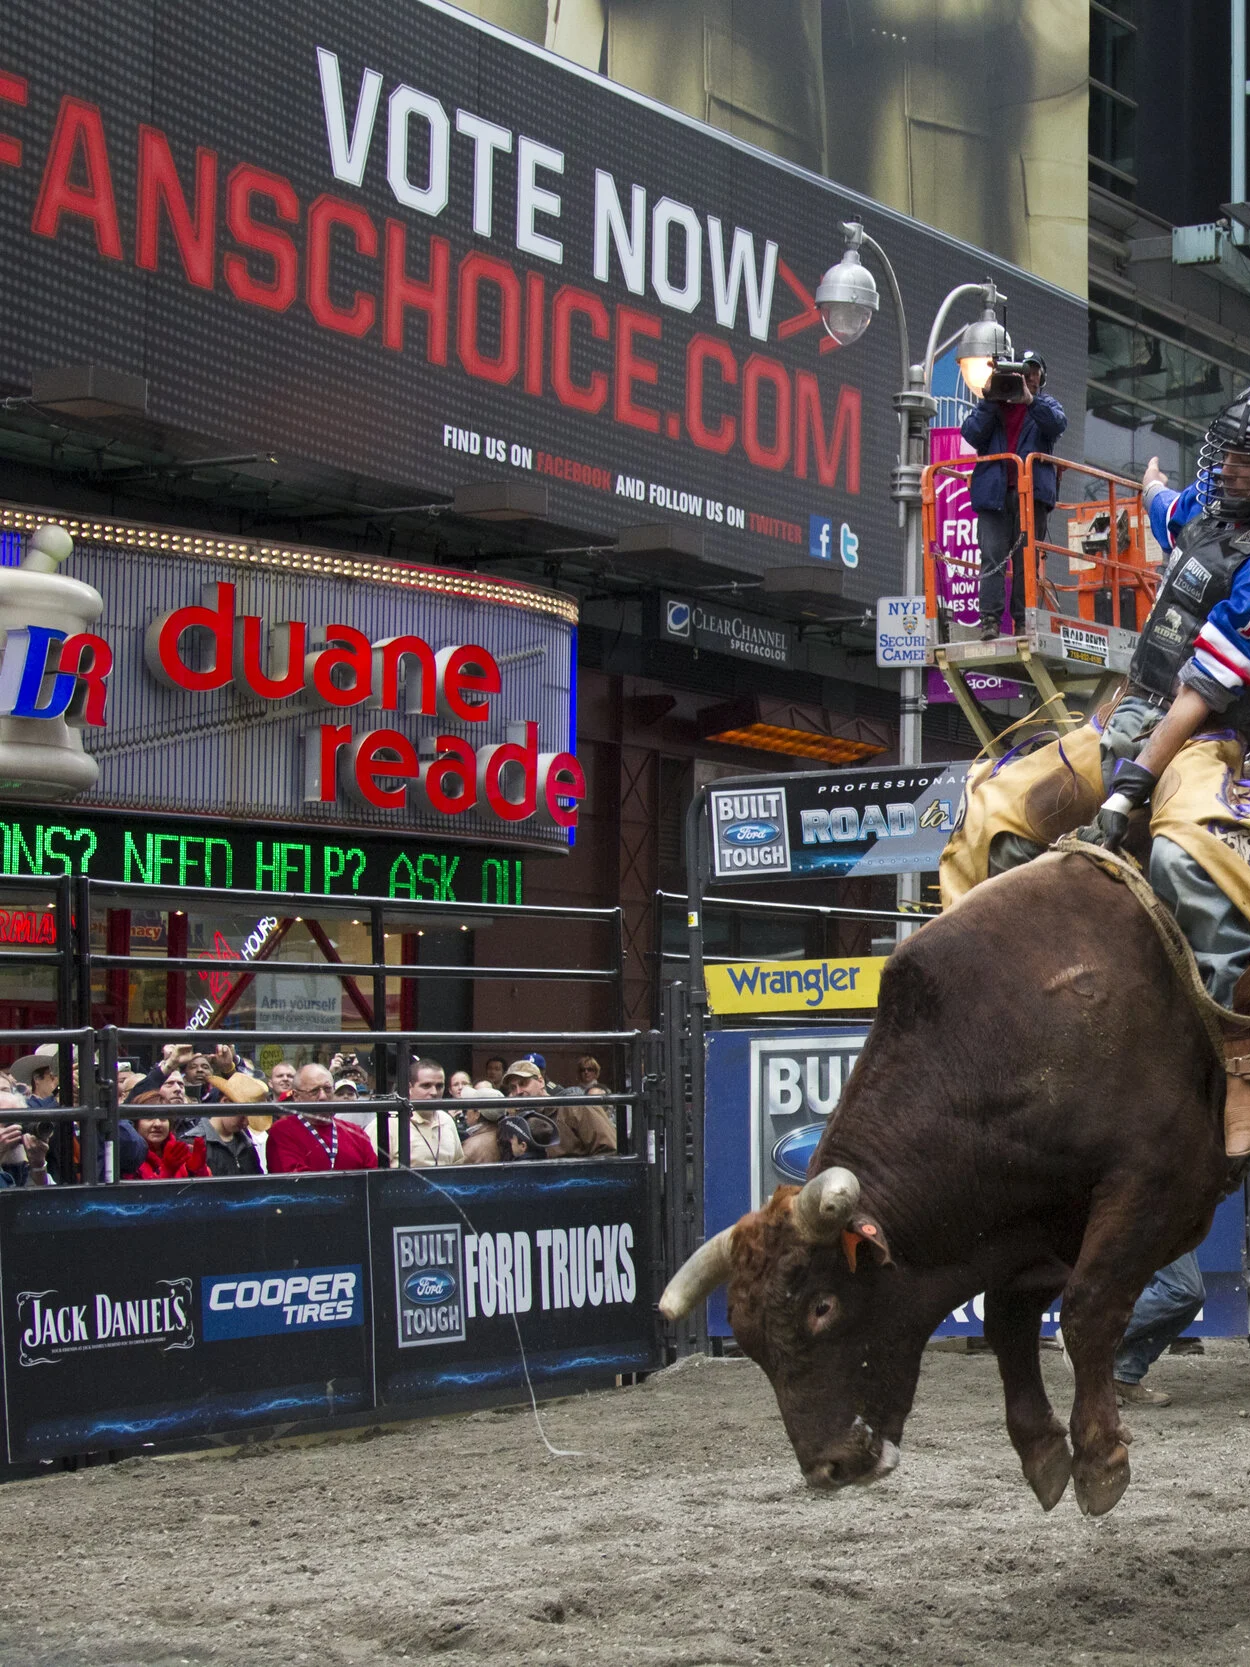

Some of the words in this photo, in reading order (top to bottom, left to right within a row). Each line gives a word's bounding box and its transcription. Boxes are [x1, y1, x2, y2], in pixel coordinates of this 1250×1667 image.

[316, 46, 565, 264] VOTE
[594, 168, 778, 342] NOW
[443, 424, 480, 456] FIND
[485, 436, 507, 463] US
[510, 443, 533, 470] ON
[536, 450, 612, 493] FACEBOOK
[615, 474, 645, 502] AND
[649, 484, 703, 518] FOLLOW
[705, 500, 724, 521] US
[726, 505, 745, 530] ON
[749, 512, 802, 545] TWITTER
[952, 582, 975, 596] NOW
[888, 601, 926, 616] NYP
[730, 638, 786, 662] SPECTACOLOR
[879, 634, 926, 649] SECURI
[1153, 626, 1182, 644] RIDER
[152, 582, 501, 722] duane
[314, 720, 586, 828] reade
[818, 776, 969, 794] PROFESSIONAL
[719, 794, 780, 821] BUILT
[800, 802, 917, 845] ROAD
[919, 799, 948, 829] to
[735, 826, 766, 841] Ford
[721, 846, 785, 868] TOUGH
[389, 852, 461, 902] ASK
[240, 915, 278, 961] HOURS
[727, 962, 861, 1007] Wrangler
[400, 1233, 457, 1268] BUILT
[416, 1276, 444, 1296] Ford
[464, 1231, 533, 1319] FORD
[535, 1222, 637, 1311] TRUCKS
[209, 1271, 357, 1311] COOPER
[24, 1298, 89, 1347] JACK
[95, 1288, 187, 1341] DANIEL'S
[281, 1299, 354, 1326] TIRES
[403, 1304, 460, 1335] TOUGH
